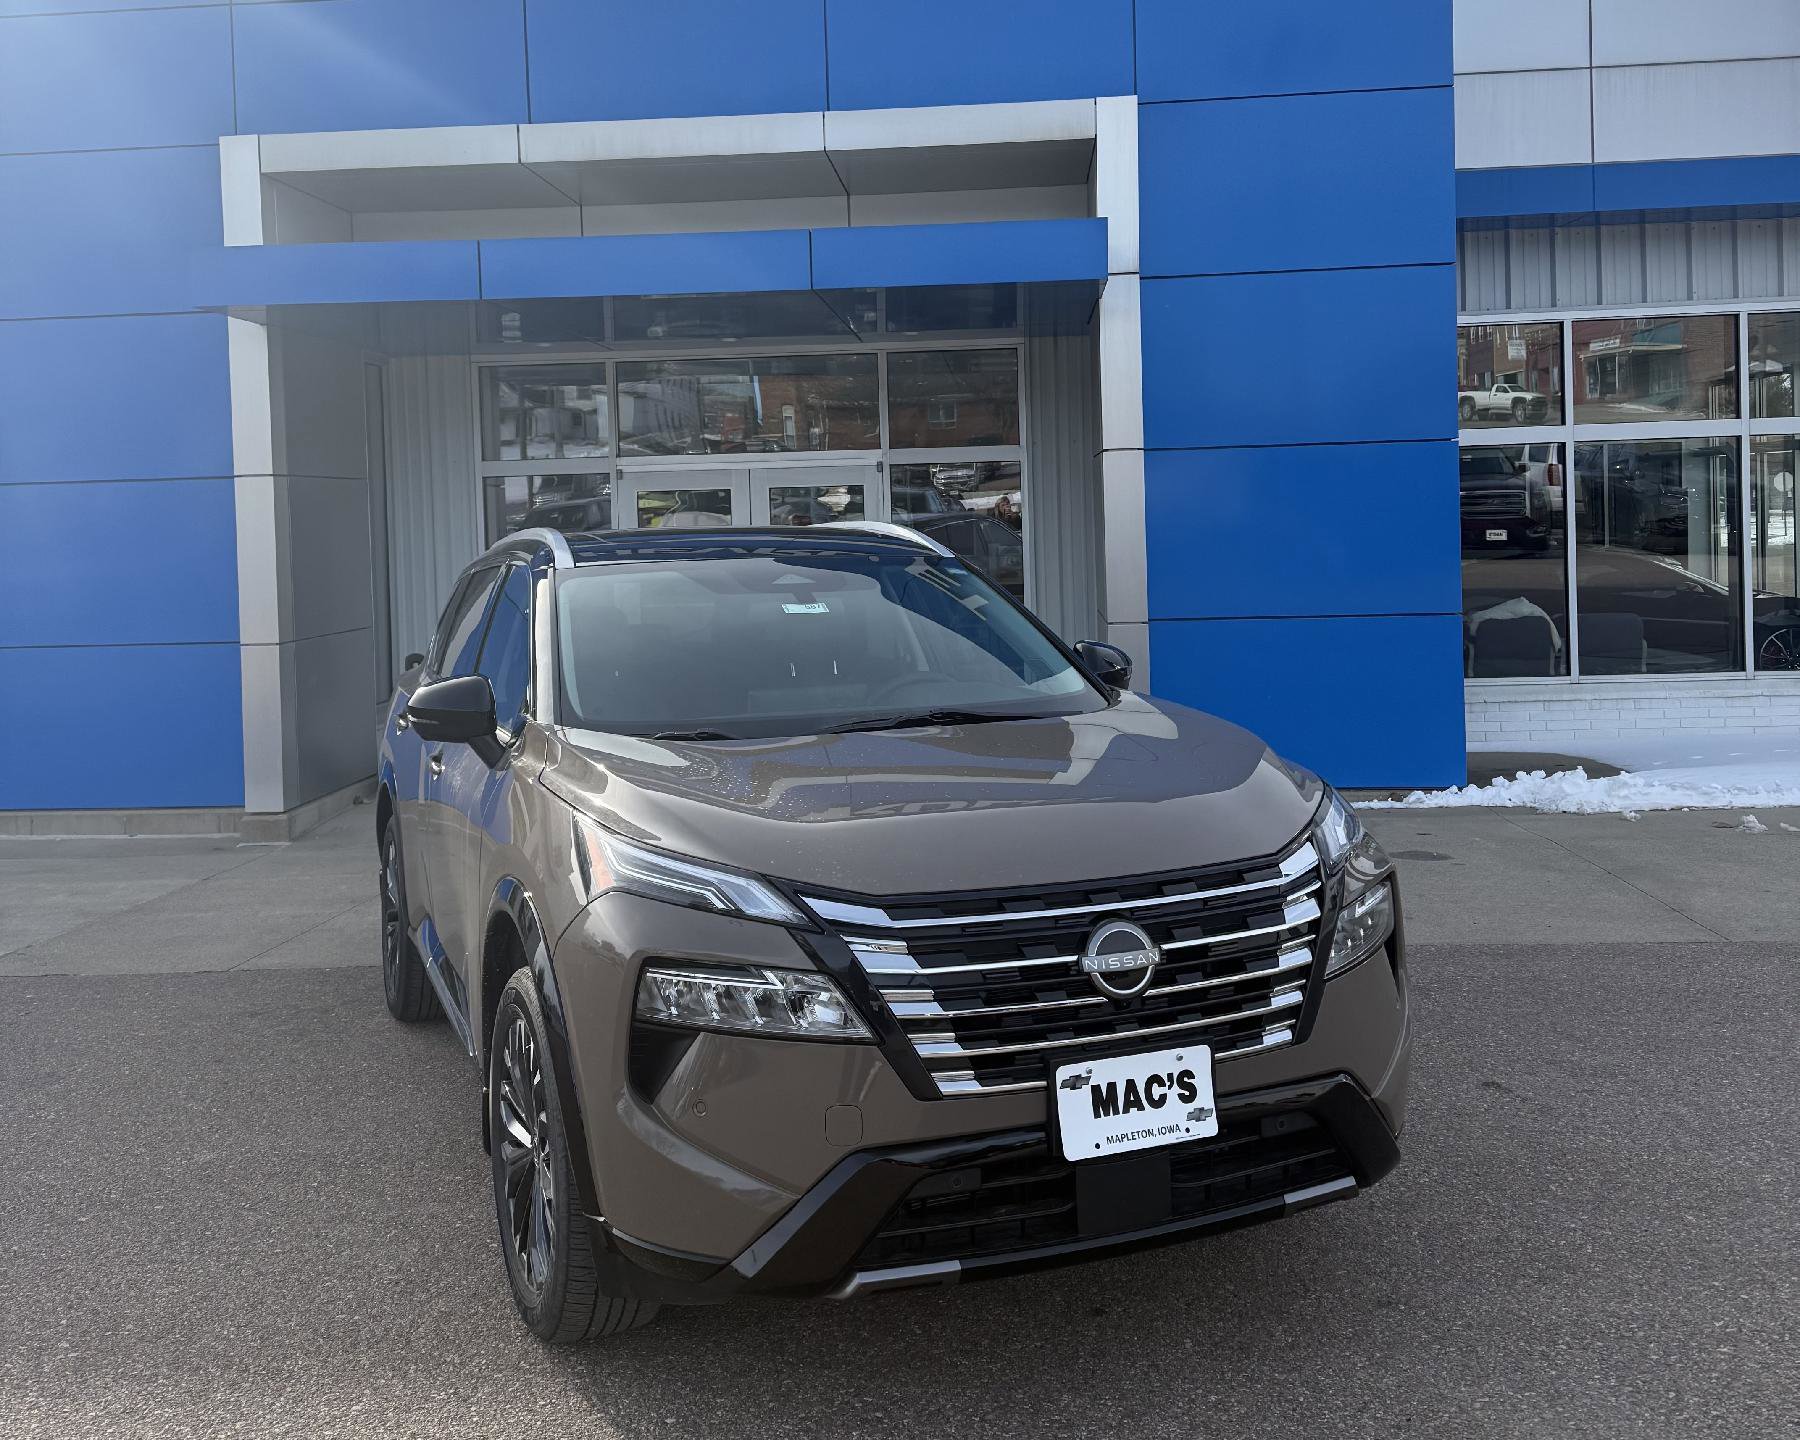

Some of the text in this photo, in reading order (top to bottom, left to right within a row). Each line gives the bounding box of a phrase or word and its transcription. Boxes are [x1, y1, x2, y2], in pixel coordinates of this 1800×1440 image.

[1085, 951, 1159, 970] NISSAN
[1091, 1069, 1198, 1119] MAC'S
[1106, 1128, 1157, 1145] MAPLETON,
[1158, 1123, 1181, 1137] IOWA
